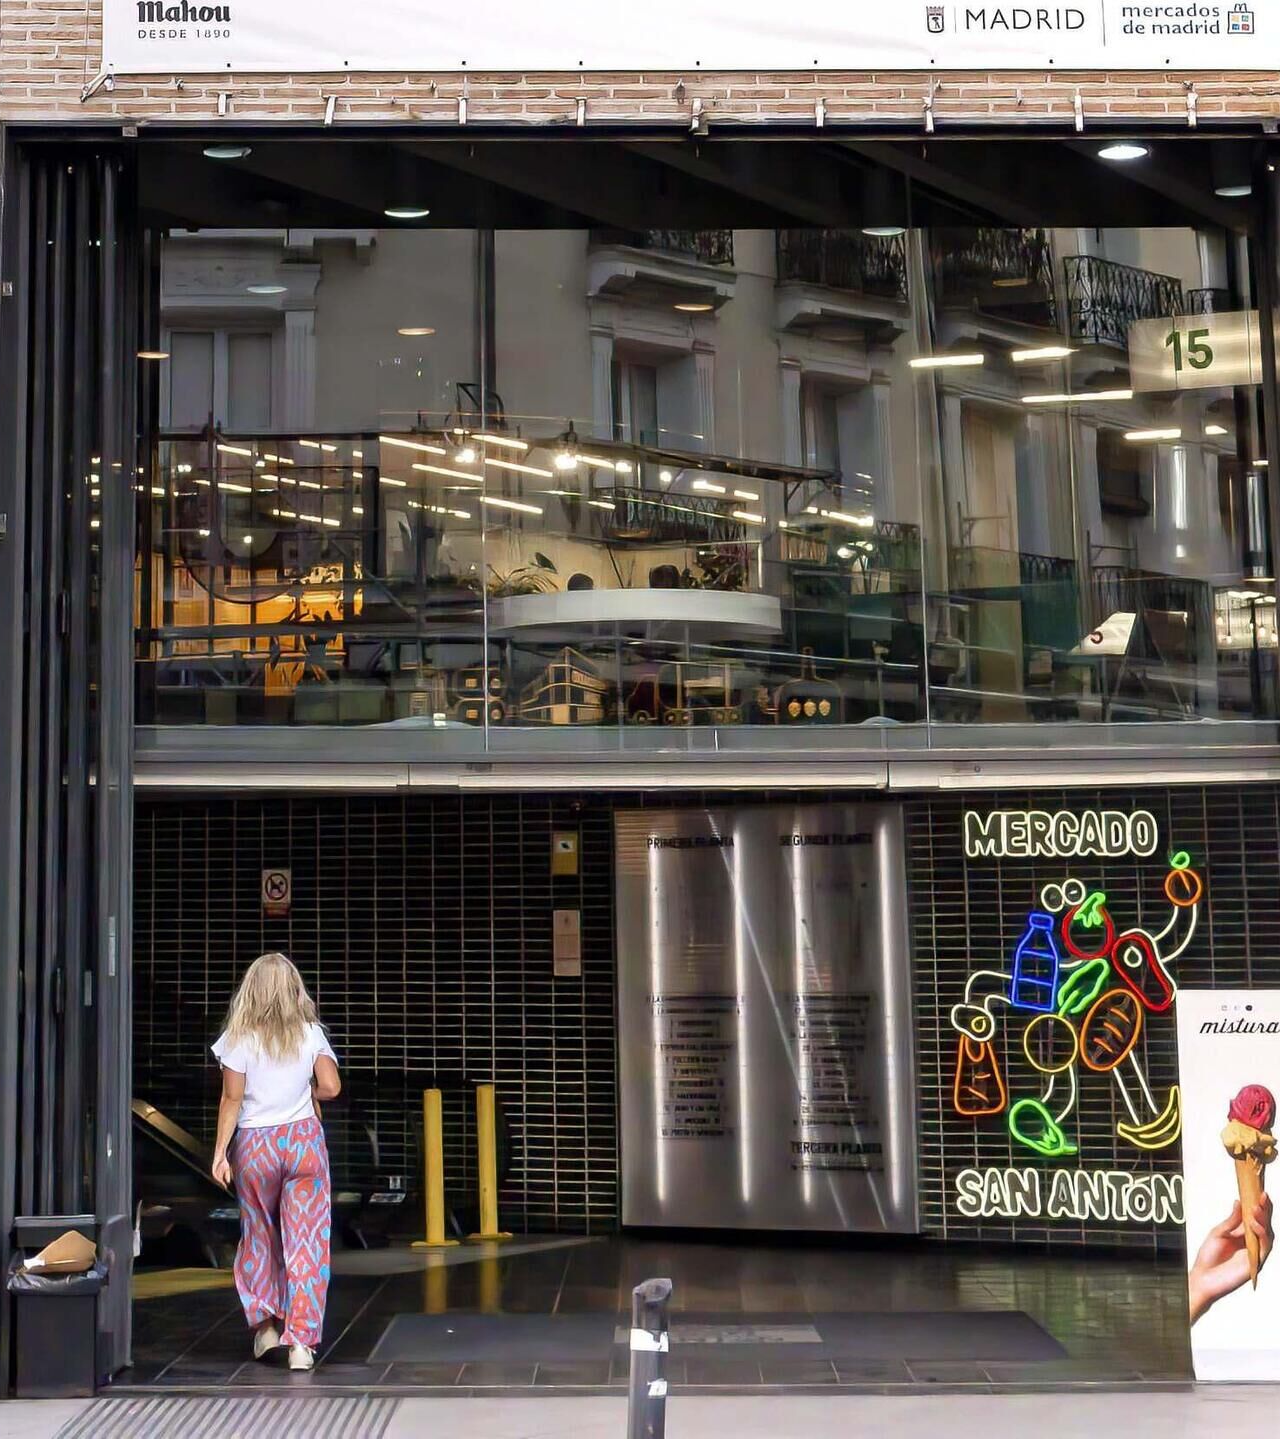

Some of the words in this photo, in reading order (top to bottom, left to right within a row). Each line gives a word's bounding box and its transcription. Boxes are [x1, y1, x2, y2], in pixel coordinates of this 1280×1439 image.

[136, 0, 232, 23] Mahou
[965, 8, 1085, 31] MADRID
[1122, 2, 1221, 18] mercados
[137, 29, 187, 39] DESDE
[196, 29, 230, 39] 1890
[1122, 19, 1145, 36] de
[1151, 19, 1221, 35] madrid
[1164, 328, 1214, 372] 15
[964, 810, 1158, 857] MERCADO
[955, 1167, 1042, 1218] SAN
